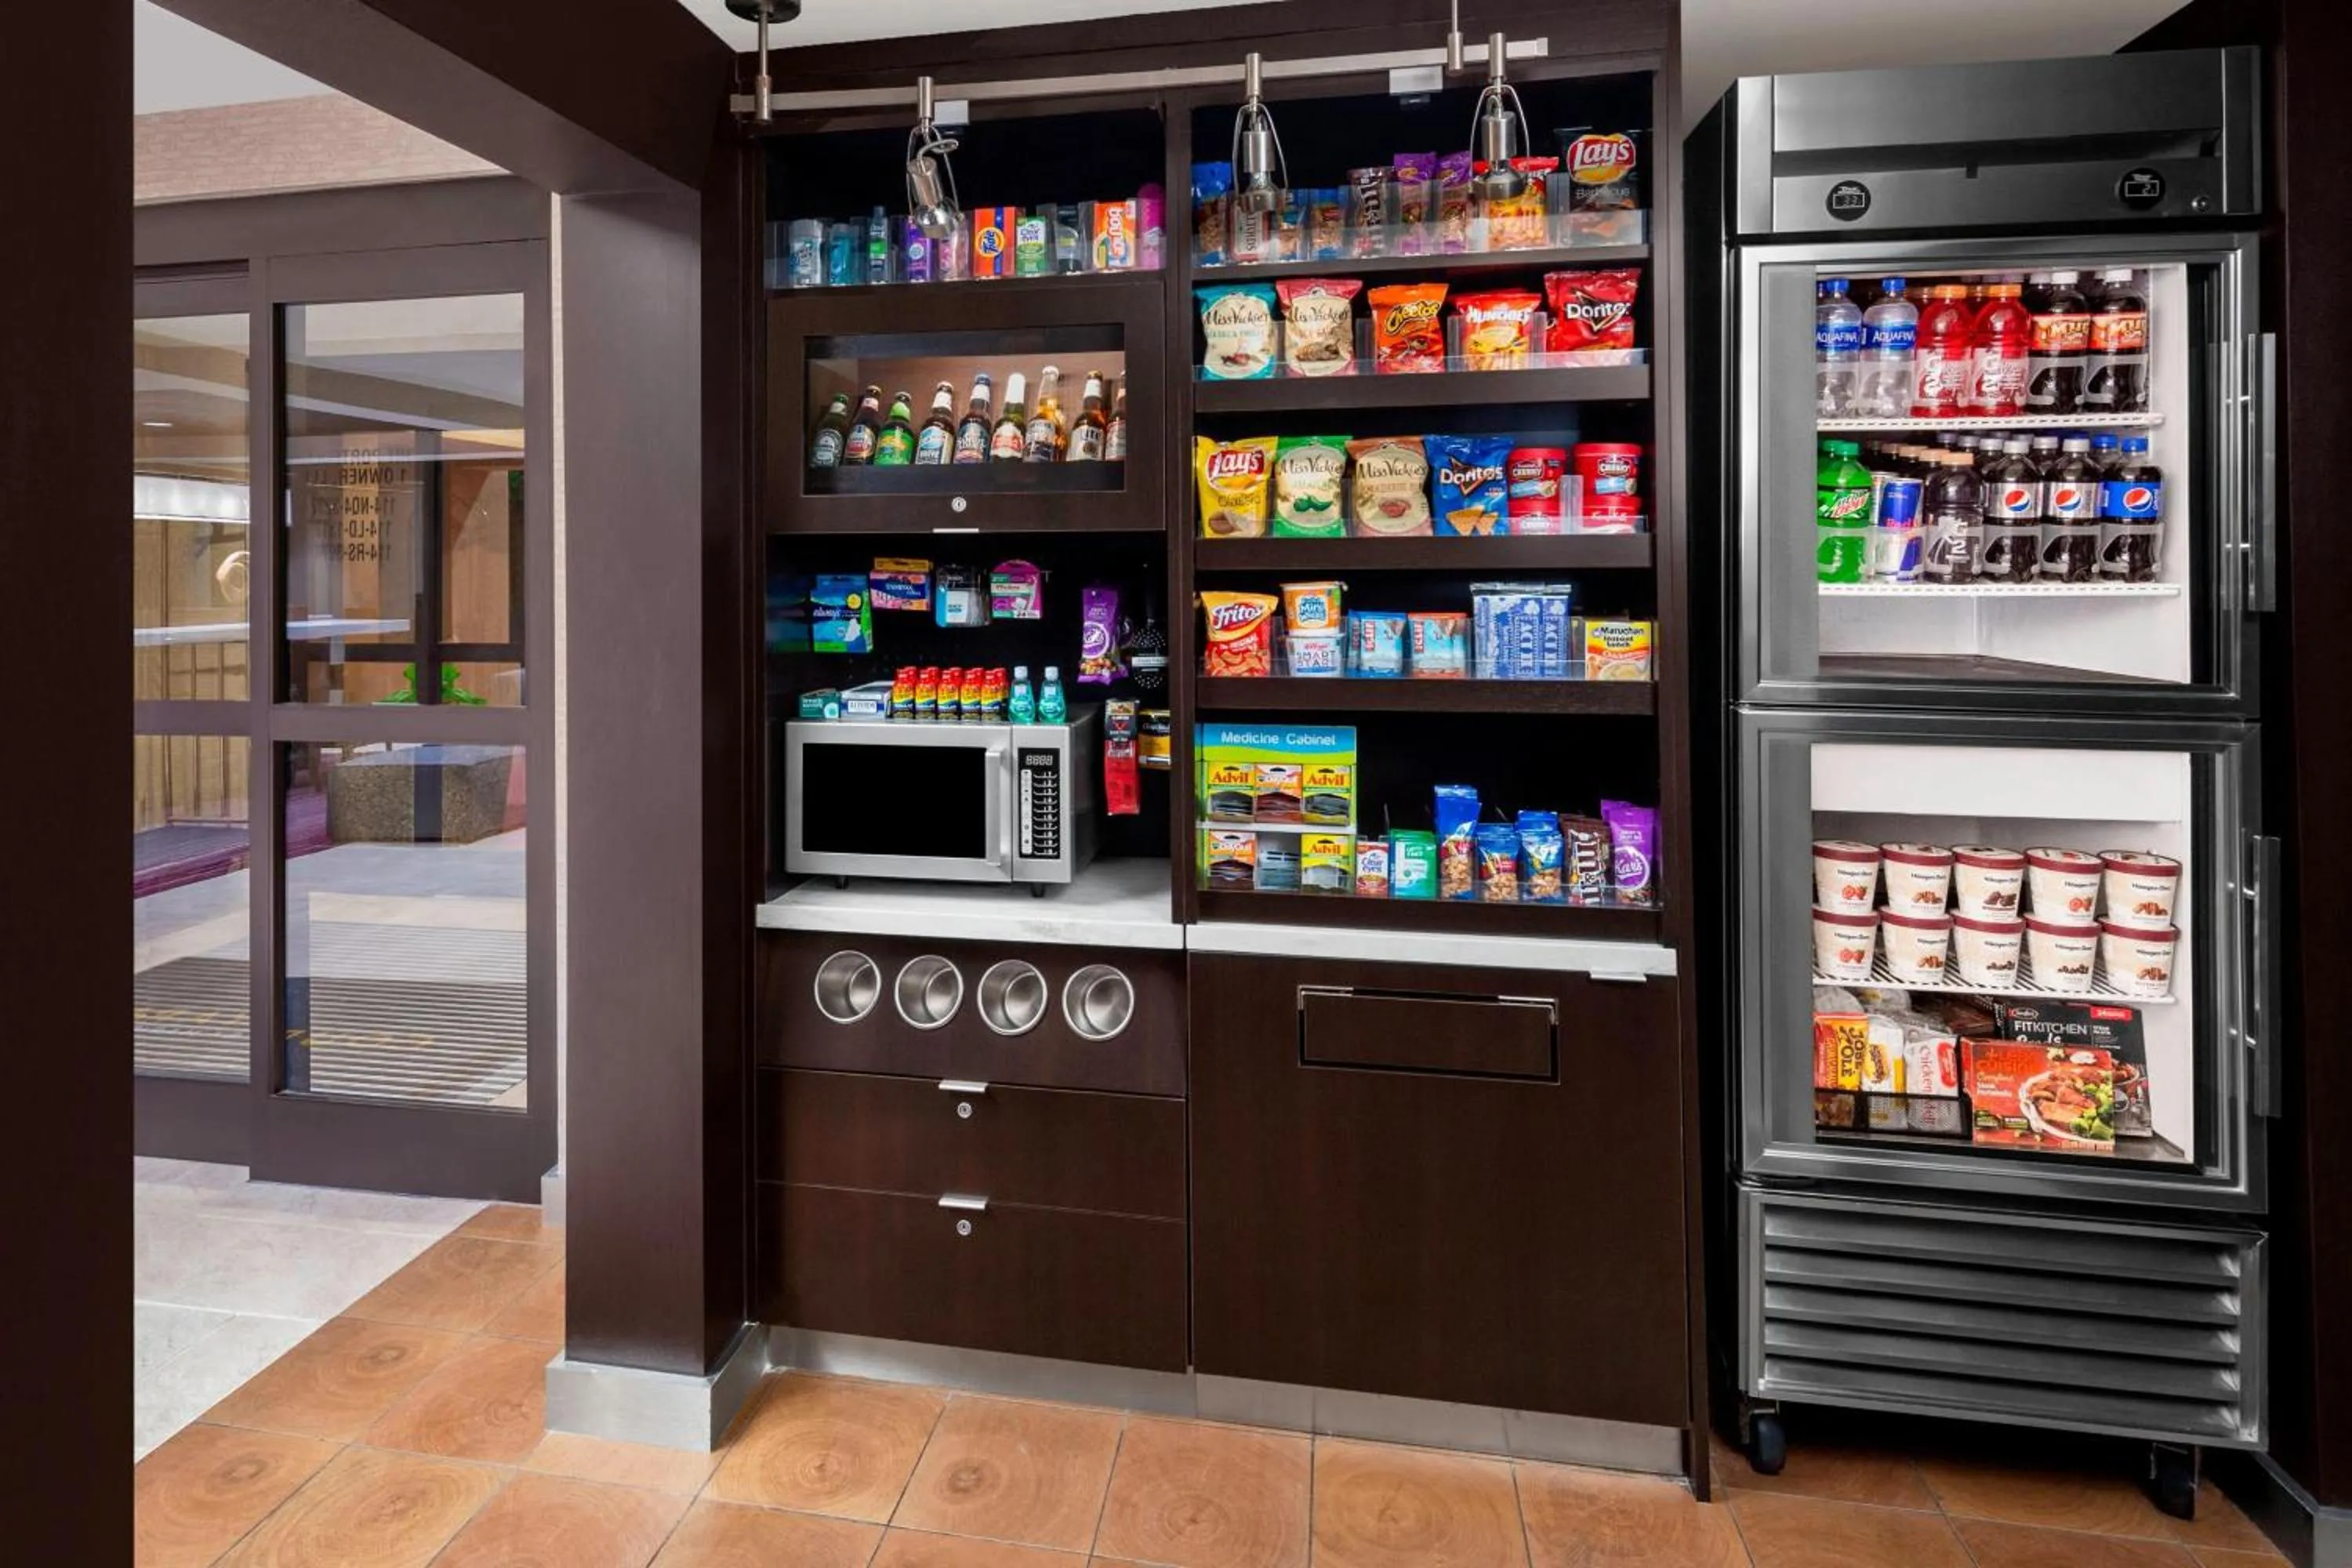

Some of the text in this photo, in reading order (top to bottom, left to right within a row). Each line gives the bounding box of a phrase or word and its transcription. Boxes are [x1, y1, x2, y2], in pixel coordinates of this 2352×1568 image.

[1574, 140, 1630, 170] Lay's
[982, 230, 1000, 254] Tide
[1387, 301, 1439, 332] Cheetos
[1817, 332, 1857, 343] AQUAFINA
[1209, 452, 1262, 480] Lay's
[1439, 466, 1504, 485] Doritos
[1601, 626, 1644, 635] Maruchan
[1221, 731, 1336, 746] Medicine Cabinet
[1213, 771, 1250, 784] Advil
[1308, 773, 1345, 786] Advil
[1310, 844, 1341, 855] Advil
